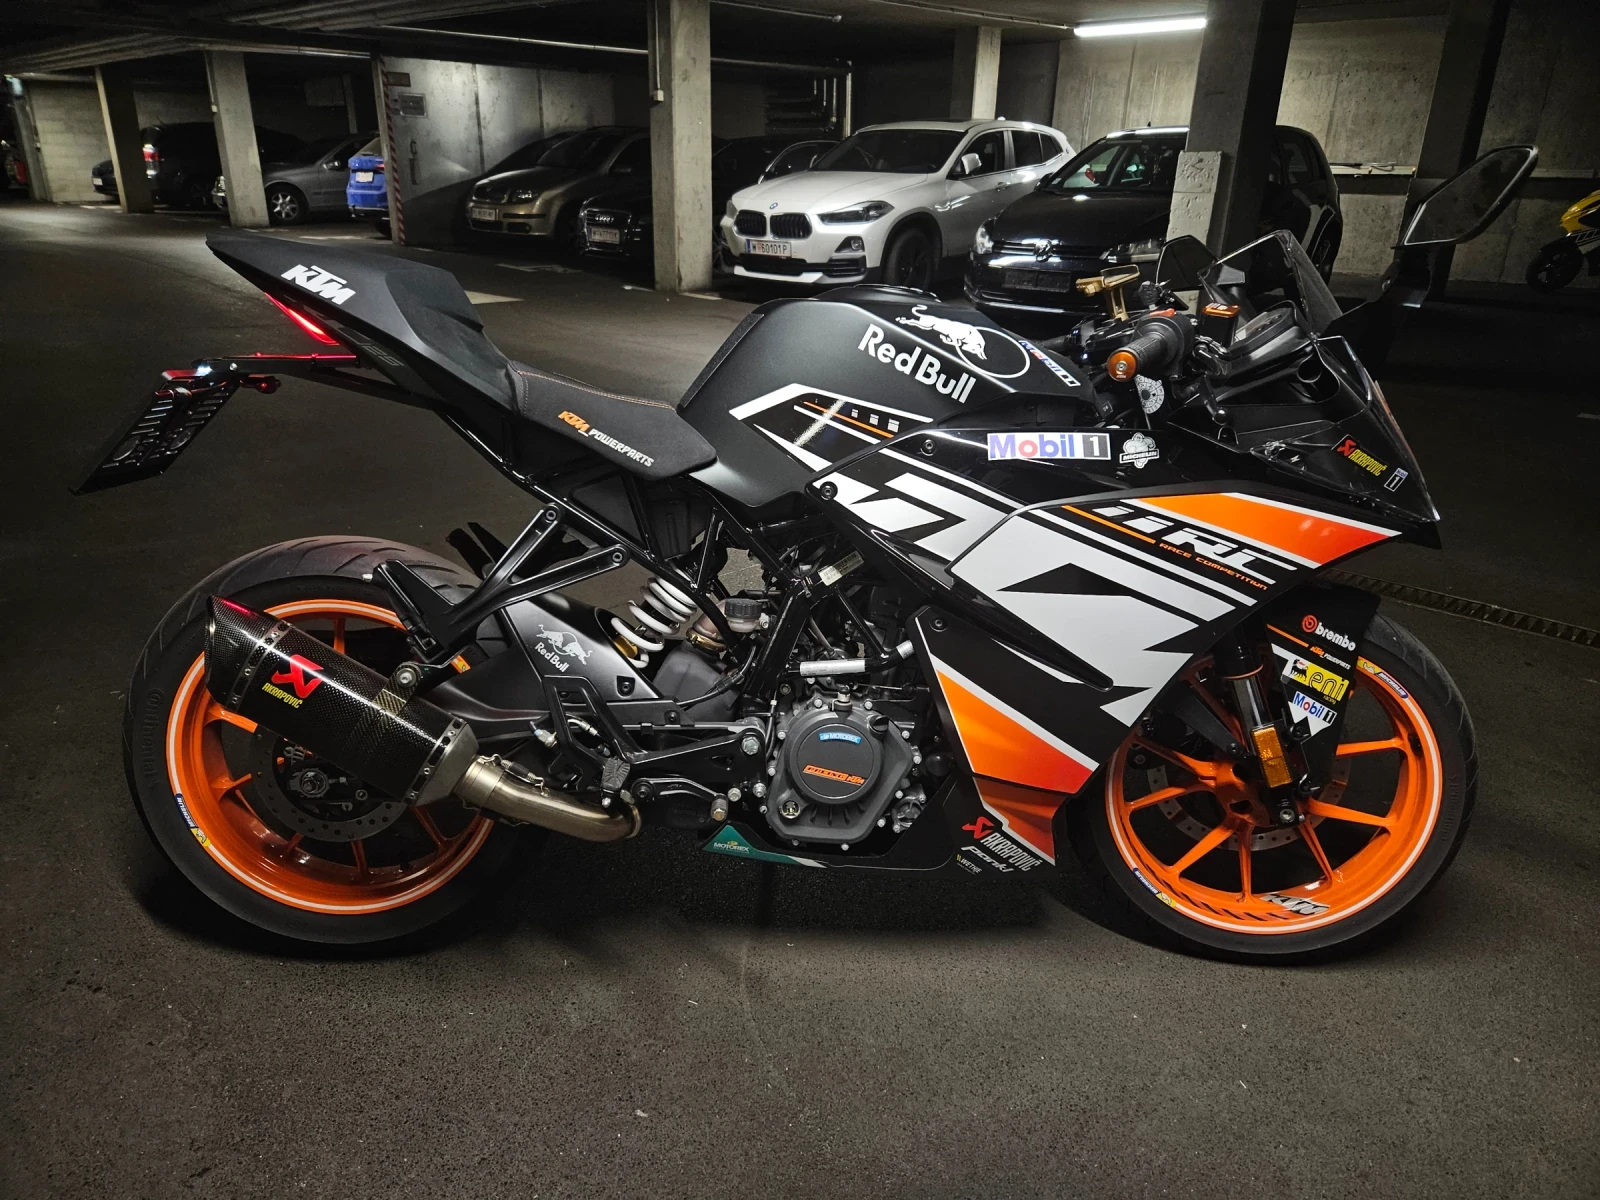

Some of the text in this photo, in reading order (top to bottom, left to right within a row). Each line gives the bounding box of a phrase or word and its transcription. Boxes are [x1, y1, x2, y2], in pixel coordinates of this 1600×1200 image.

[280, 263, 357, 306] KTM
[557, 410, 655, 467] KTM POWERPARTS
[989, 433, 1100, 459] Mobil 1
[1122, 450, 1158, 462] MICHELIN
[1158, 542, 1268, 591] RACE COMPETITION
[1314, 621, 1357, 652] brembo
[1309, 671, 1345, 701] eni
[1293, 692, 1325, 719] Mobil
[713, 842, 750, 852] MOTOREX
[1259, 893, 1331, 916] KTM
